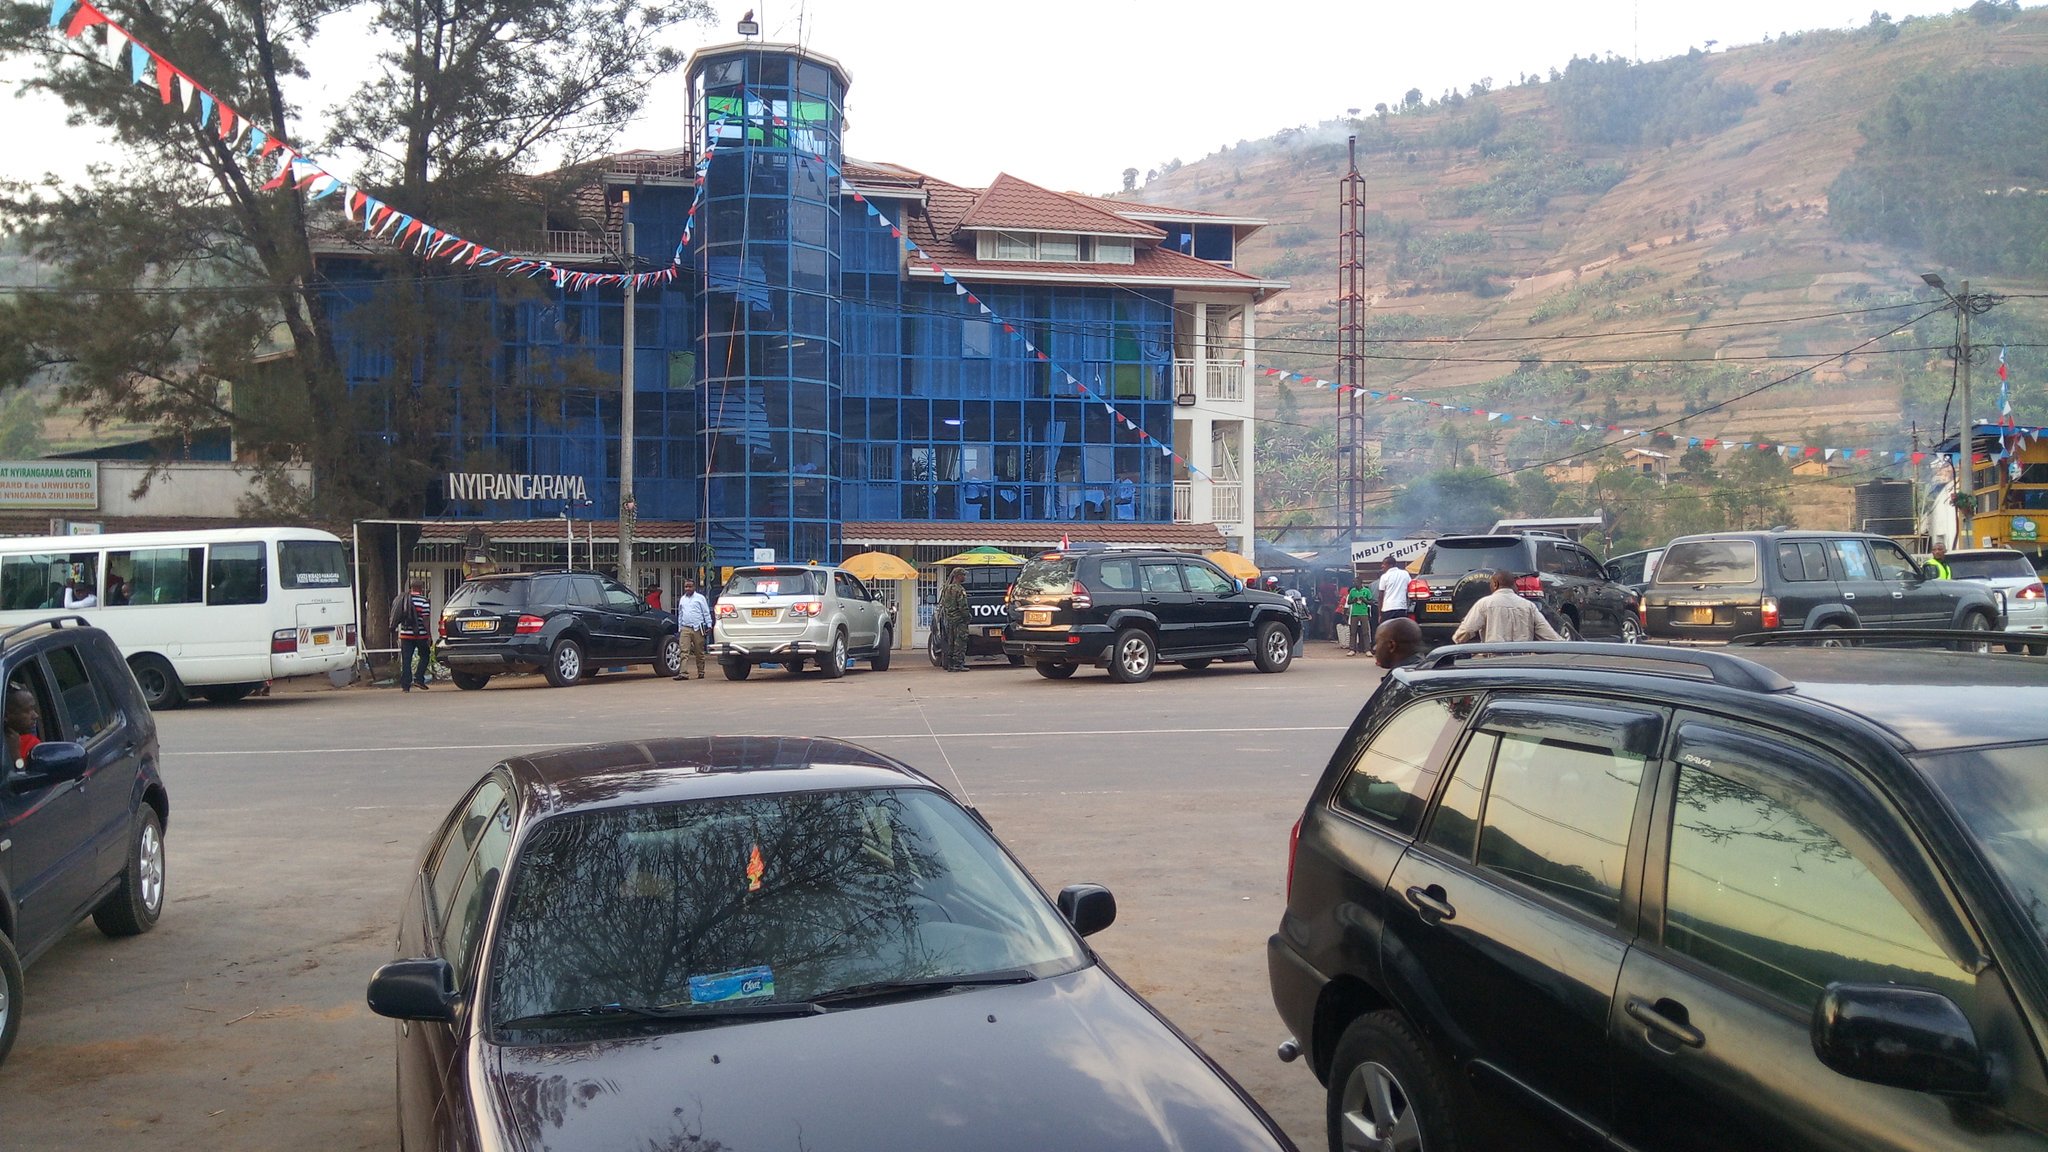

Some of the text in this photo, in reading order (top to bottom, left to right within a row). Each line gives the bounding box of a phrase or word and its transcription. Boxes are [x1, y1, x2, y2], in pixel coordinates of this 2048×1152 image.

[10, 468, 64, 477] NYIRANGARAMA
[65, 468, 92, 478] CENTER
[449, 472, 587, 500] NYIRANGARAMA
[1352, 541, 1394, 562] IMBUTO
[1684, 754, 1712, 767] RAV4
